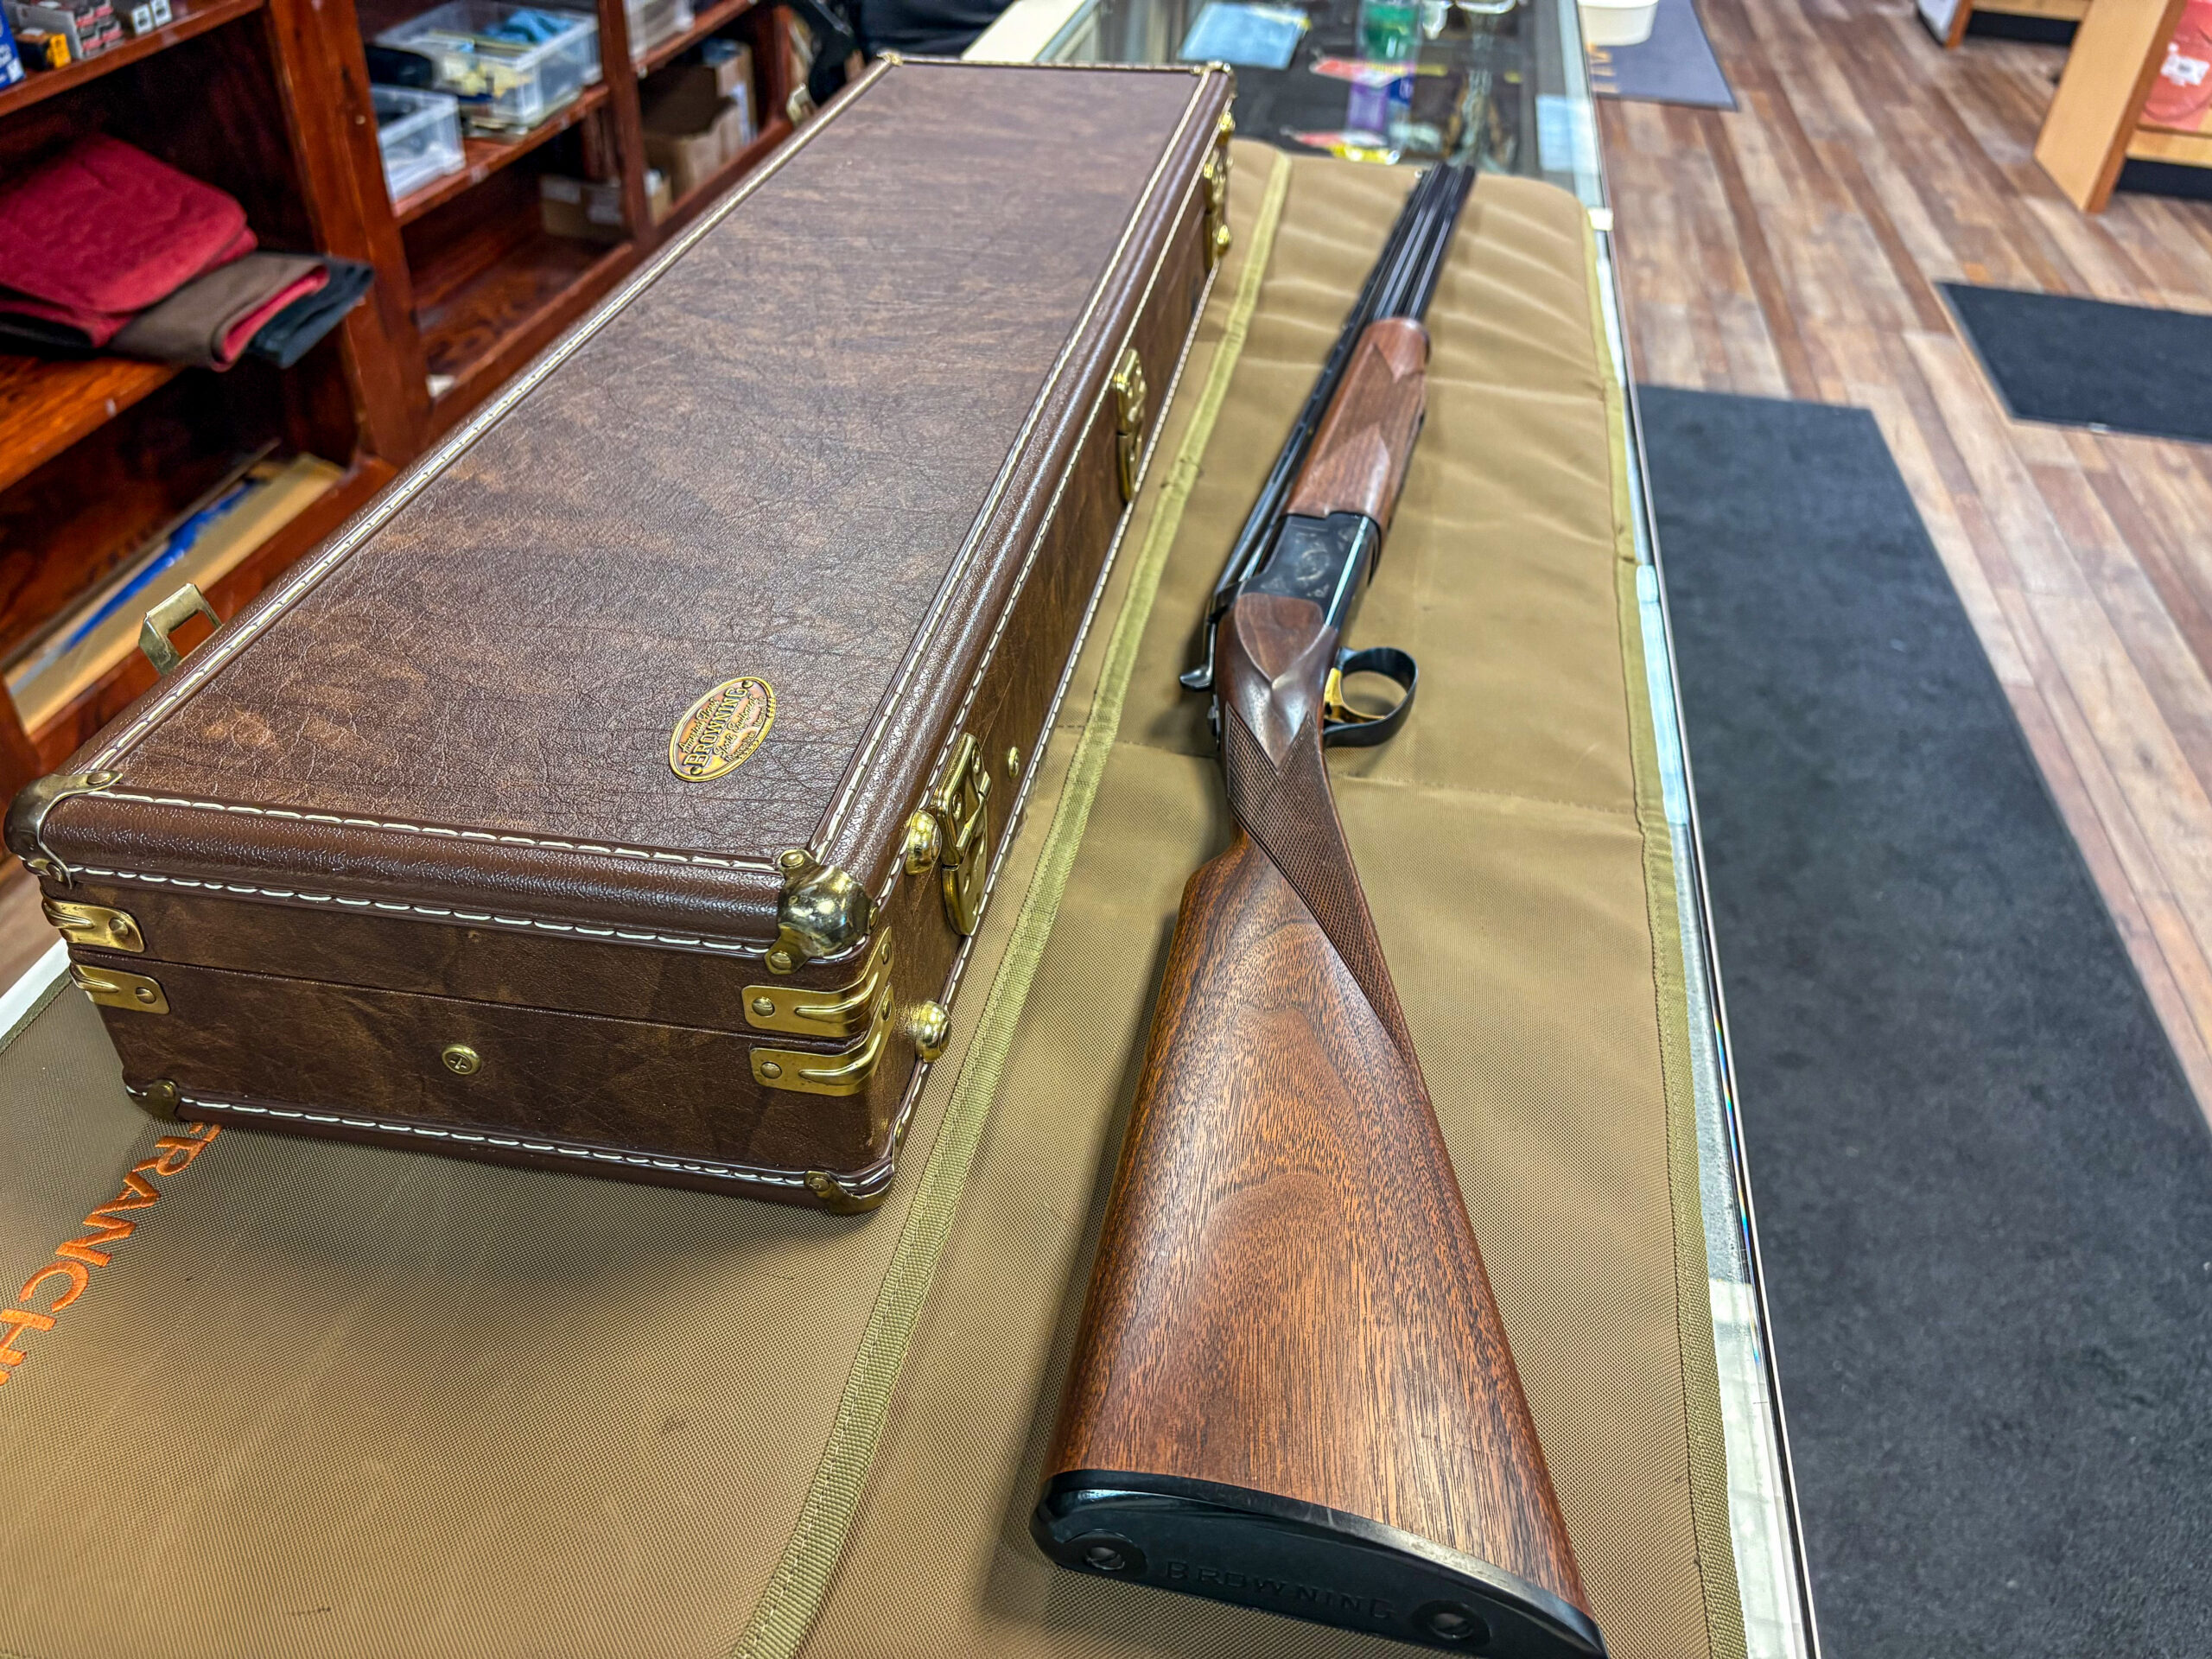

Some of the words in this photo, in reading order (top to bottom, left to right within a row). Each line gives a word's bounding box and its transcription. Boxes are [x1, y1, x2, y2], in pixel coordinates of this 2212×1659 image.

[683, 687, 749, 767] BROWNING
[728, 695, 759, 733] Equipment
[0, 1123, 223, 1386] RANCH
[1166, 1560, 1393, 1619] BROWNING
